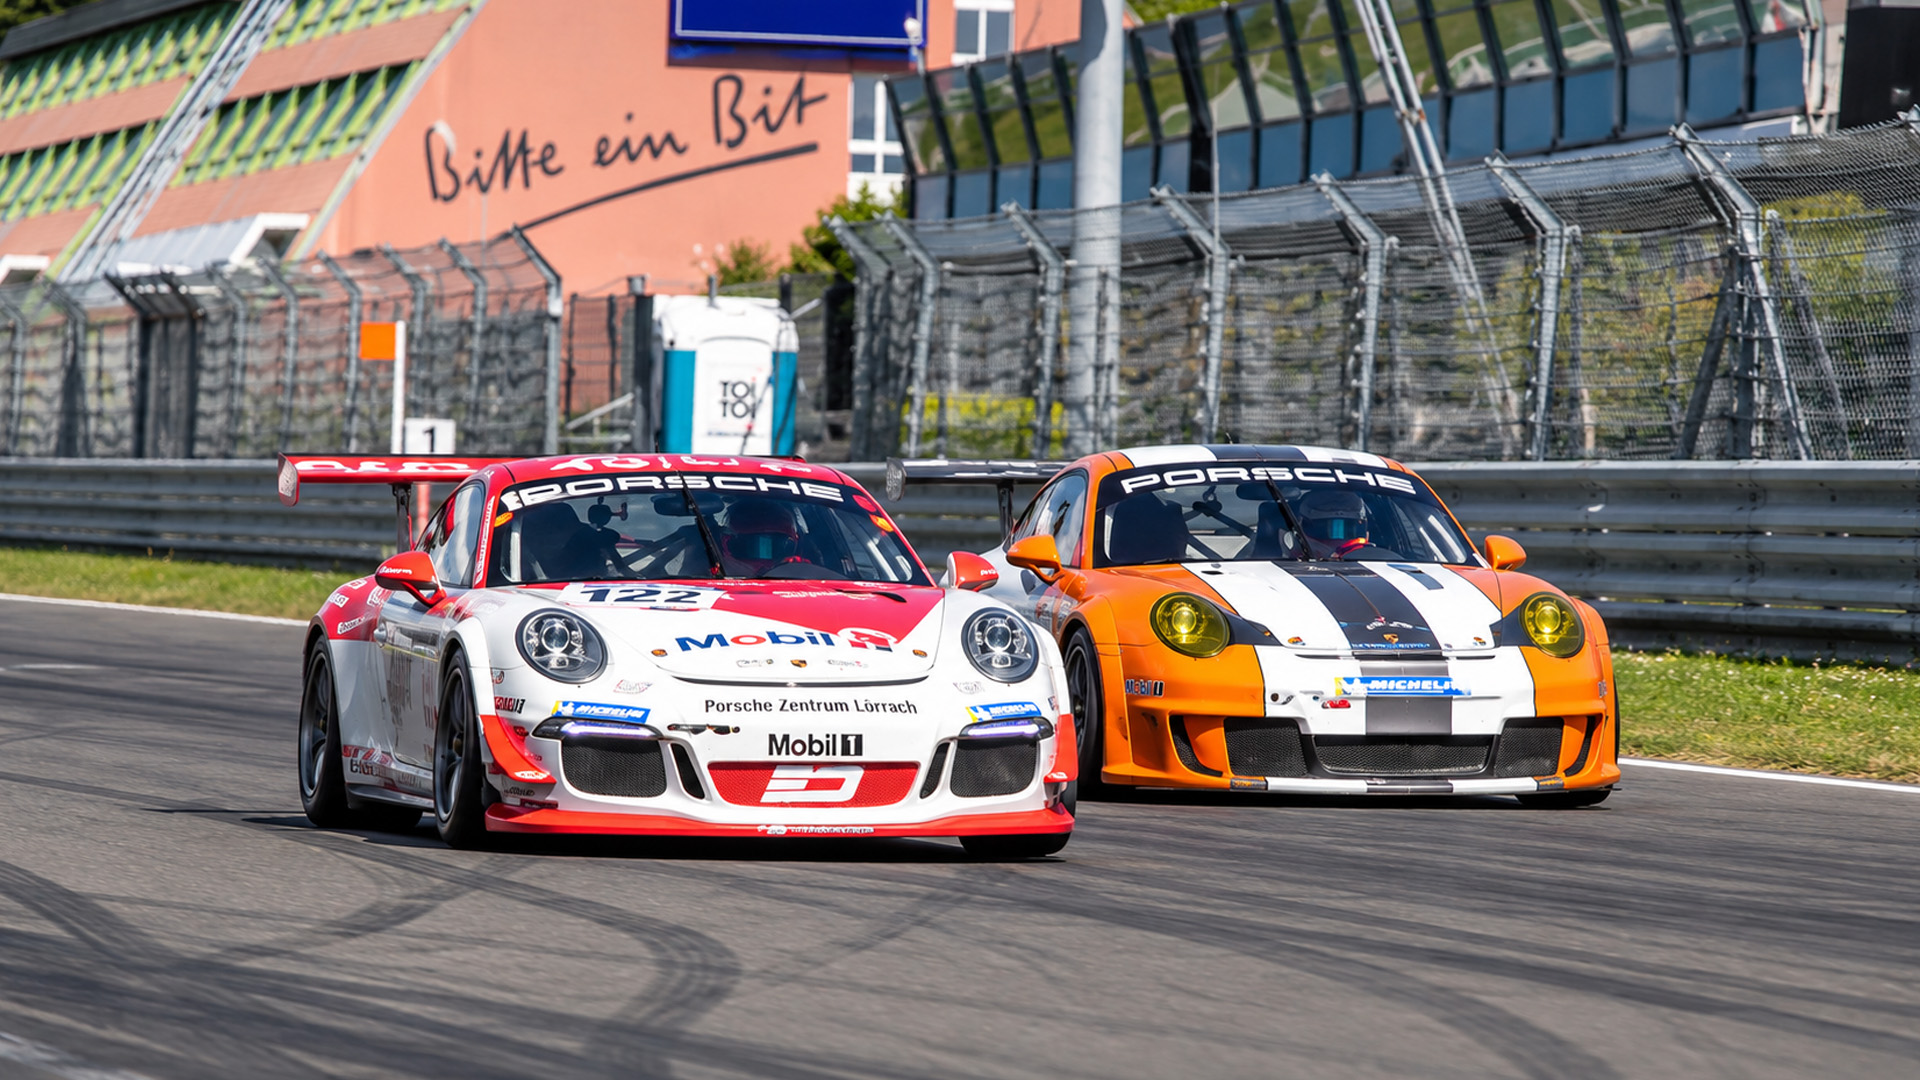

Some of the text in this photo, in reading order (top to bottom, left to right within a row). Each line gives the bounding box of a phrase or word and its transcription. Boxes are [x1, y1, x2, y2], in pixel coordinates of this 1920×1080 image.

[425, 74, 829, 202] Bitte ein Bit
[422, 425, 436, 453] 1
[518, 474, 845, 507] PORSCHE
[1120, 466, 1417, 495] PORSCHE
[580, 588, 702, 604] 122
[675, 630, 836, 654] Mobil
[705, 698, 918, 715] Porsche Zentrum Lörrach
[768, 734, 837, 756] Mobil
